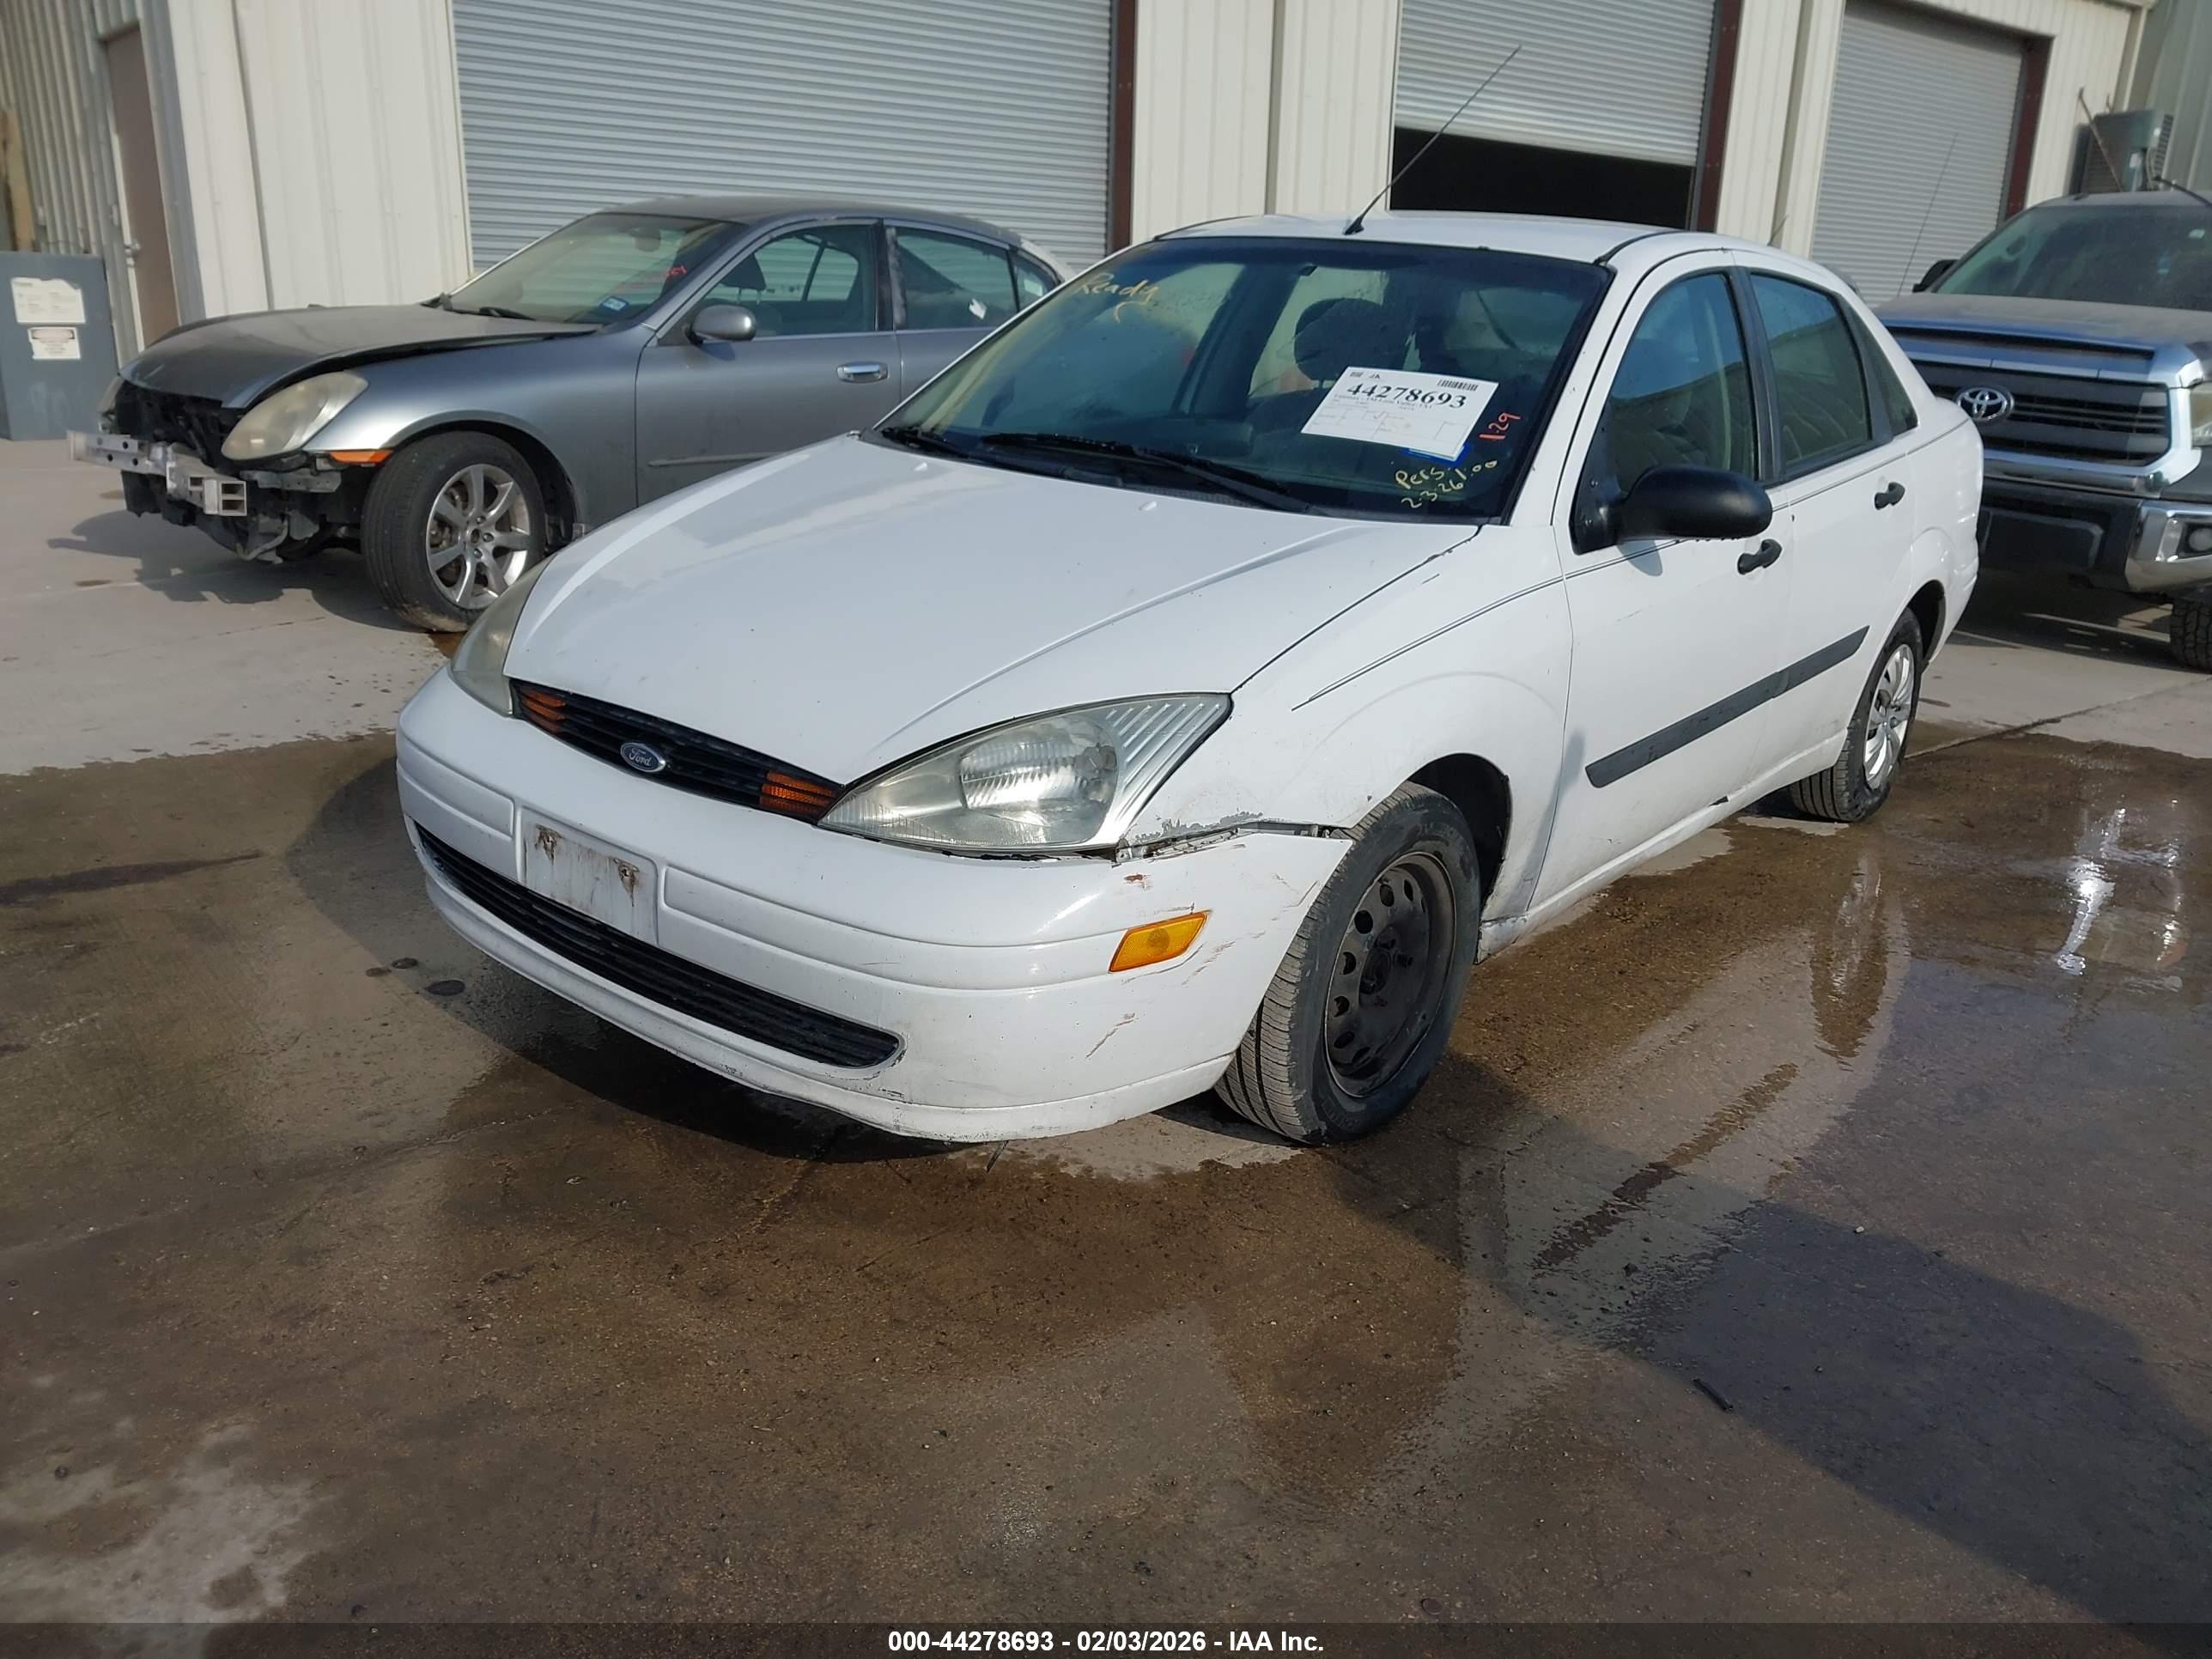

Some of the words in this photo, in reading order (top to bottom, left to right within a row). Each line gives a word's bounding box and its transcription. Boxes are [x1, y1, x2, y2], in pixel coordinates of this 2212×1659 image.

[1075, 272, 1159, 321] Ready
[1346, 382, 1468, 409] 44278693
[629, 747, 652, 766] Ford
